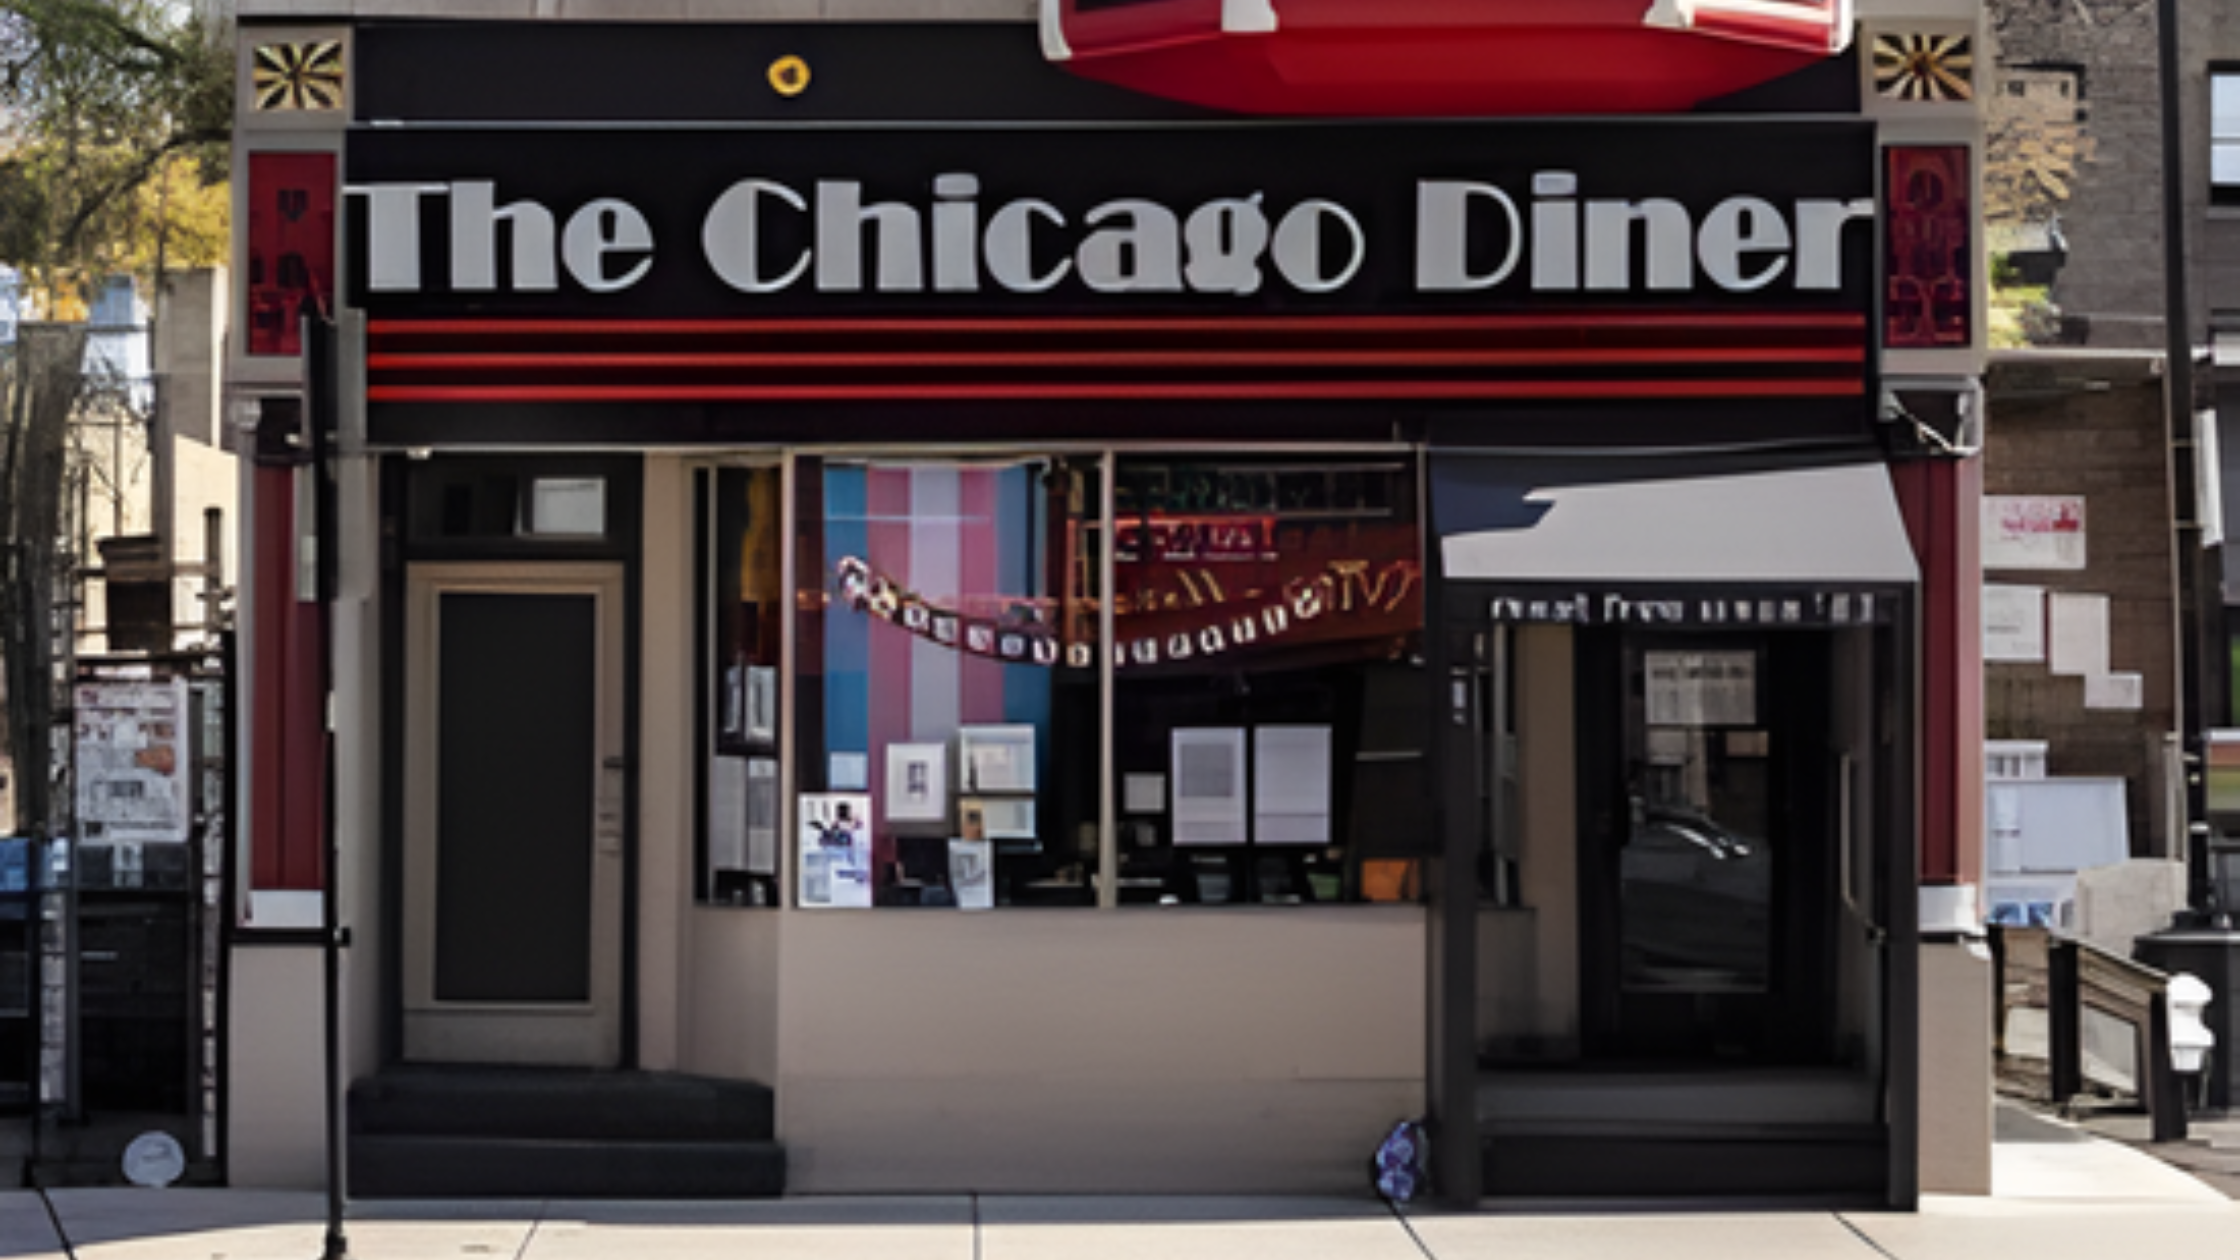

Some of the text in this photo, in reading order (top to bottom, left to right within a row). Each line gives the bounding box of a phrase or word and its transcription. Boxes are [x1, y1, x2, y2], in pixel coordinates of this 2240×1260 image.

[344, 172, 1874, 292] The Chicago Diner
